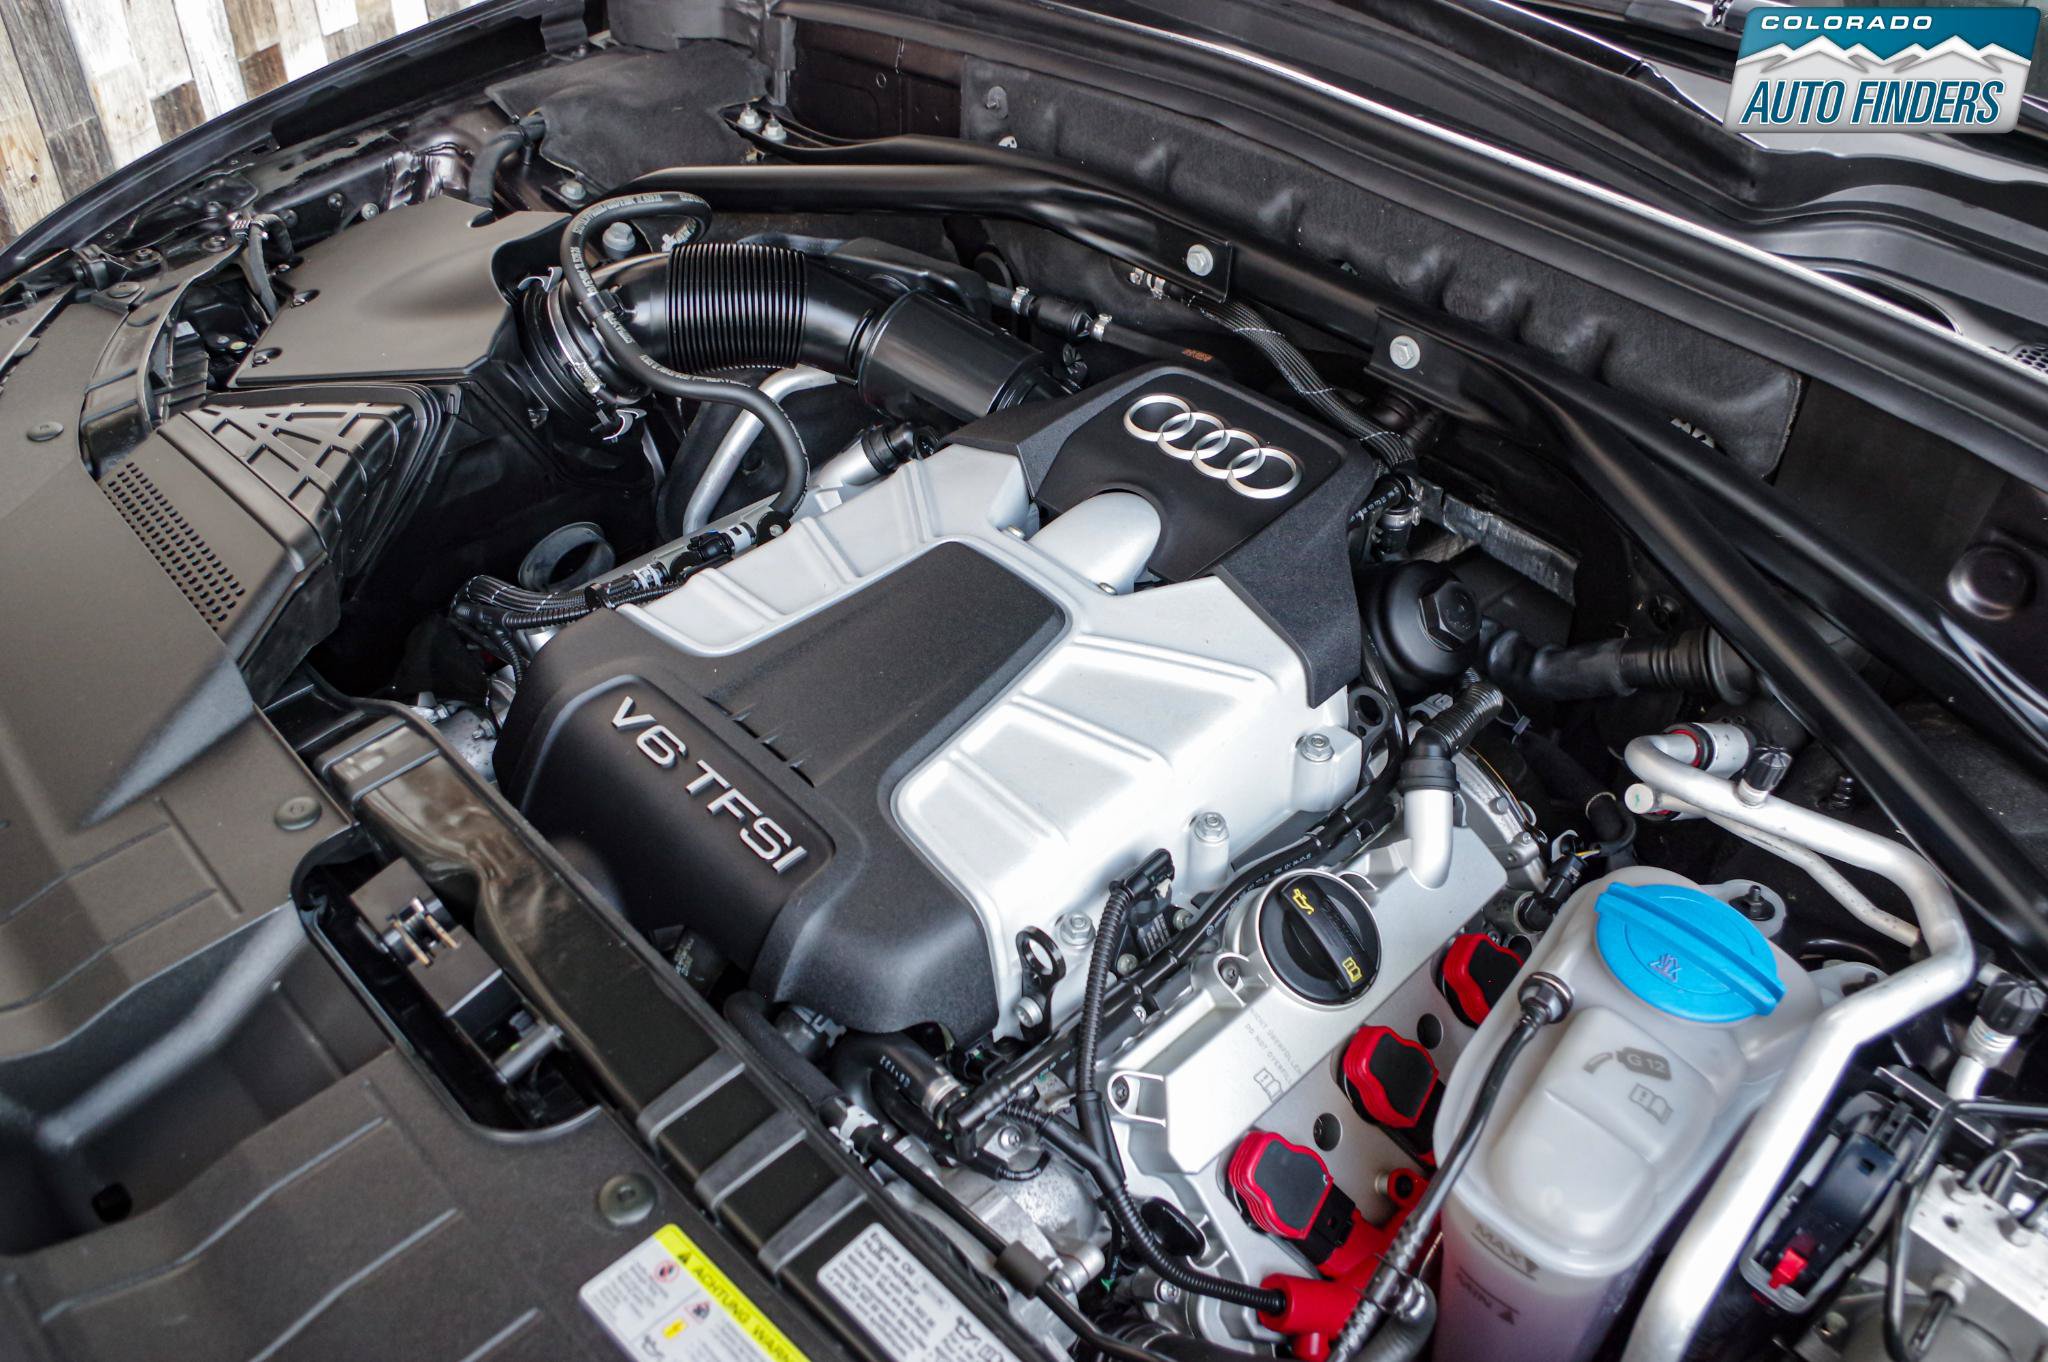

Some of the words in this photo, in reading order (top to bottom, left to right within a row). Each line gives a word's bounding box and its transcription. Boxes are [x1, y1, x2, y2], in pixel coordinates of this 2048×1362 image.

[611, 695, 687, 768] V6
[685, 759, 808, 874] TFSI
[862, 1239, 885, 1262] Huile
[885, 1262, 919, 1296] moteur
[869, 1231, 900, 1262] Engine
[901, 1262, 915, 1276] Oil
[1475, 1222, 1527, 1265] MAX
[694, 1266, 751, 1324] ACHTUNG
